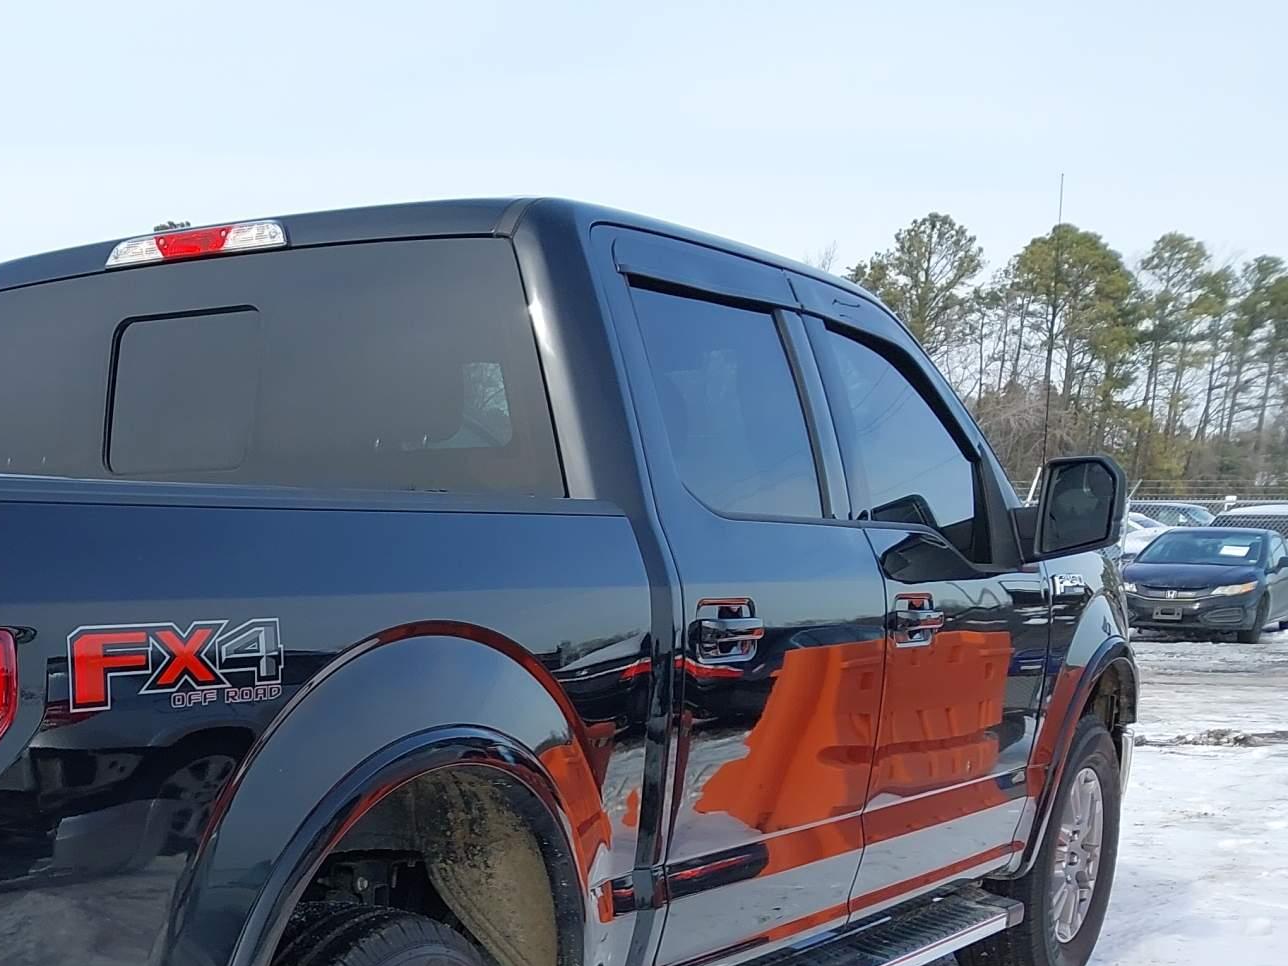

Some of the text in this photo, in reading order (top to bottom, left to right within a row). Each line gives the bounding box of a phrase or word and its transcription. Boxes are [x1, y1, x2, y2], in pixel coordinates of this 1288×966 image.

[67, 618, 284, 713] FX4
[171, 685, 282, 708] OFF ROAD
